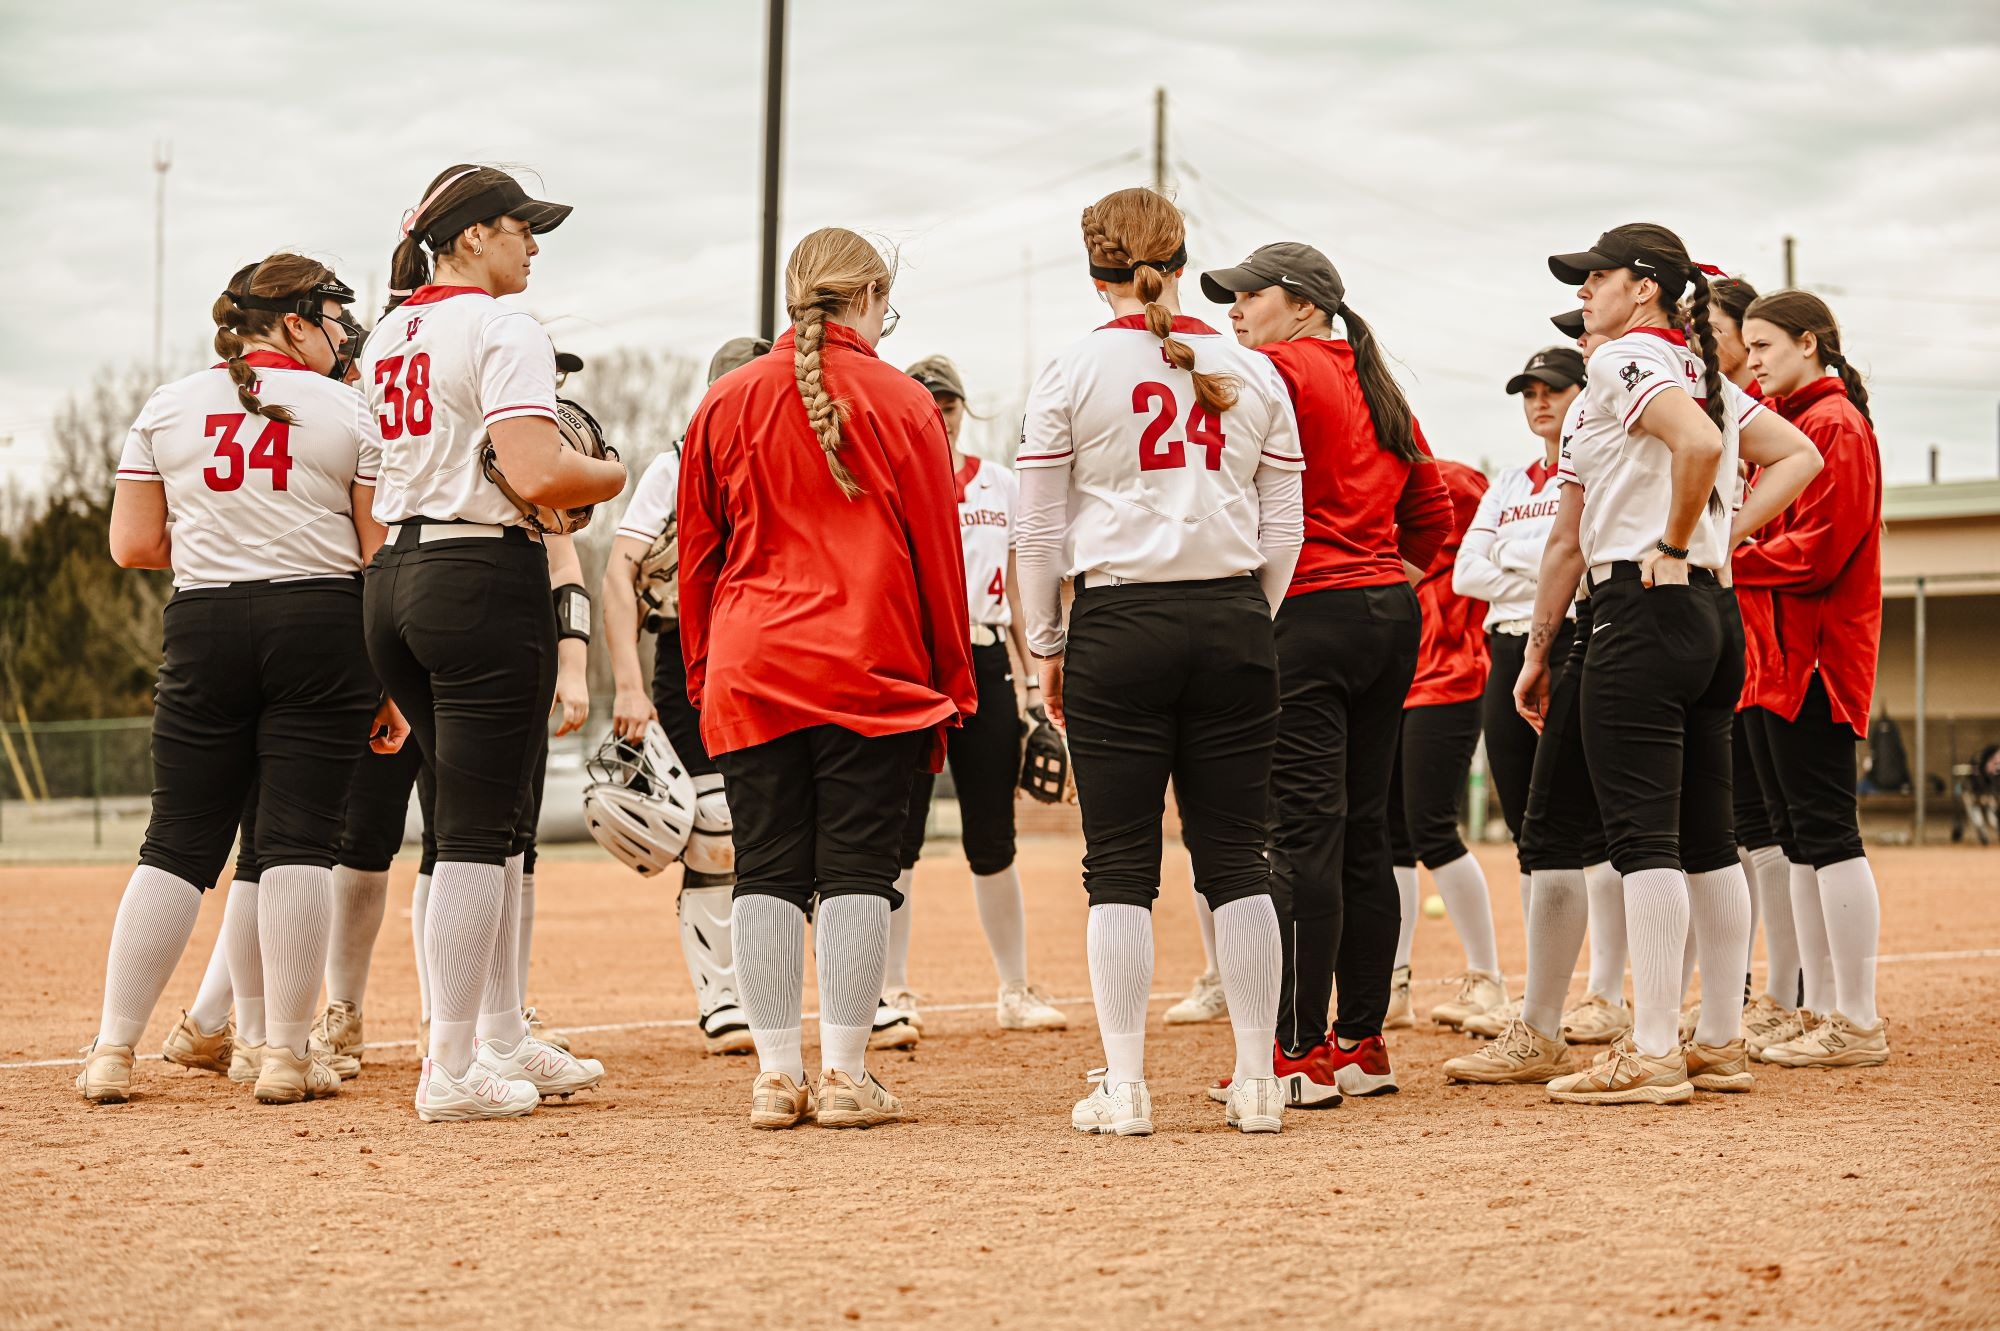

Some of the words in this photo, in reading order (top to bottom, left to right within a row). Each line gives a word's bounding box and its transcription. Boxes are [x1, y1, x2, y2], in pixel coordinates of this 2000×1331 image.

[374, 352, 433, 440] 38
[556, 406, 582, 430] 2000
[203, 413, 293, 492] 34
[1132, 381, 1226, 471] 24
[961, 508, 1008, 528] DIERS
[987, 566, 1005, 605] 4
